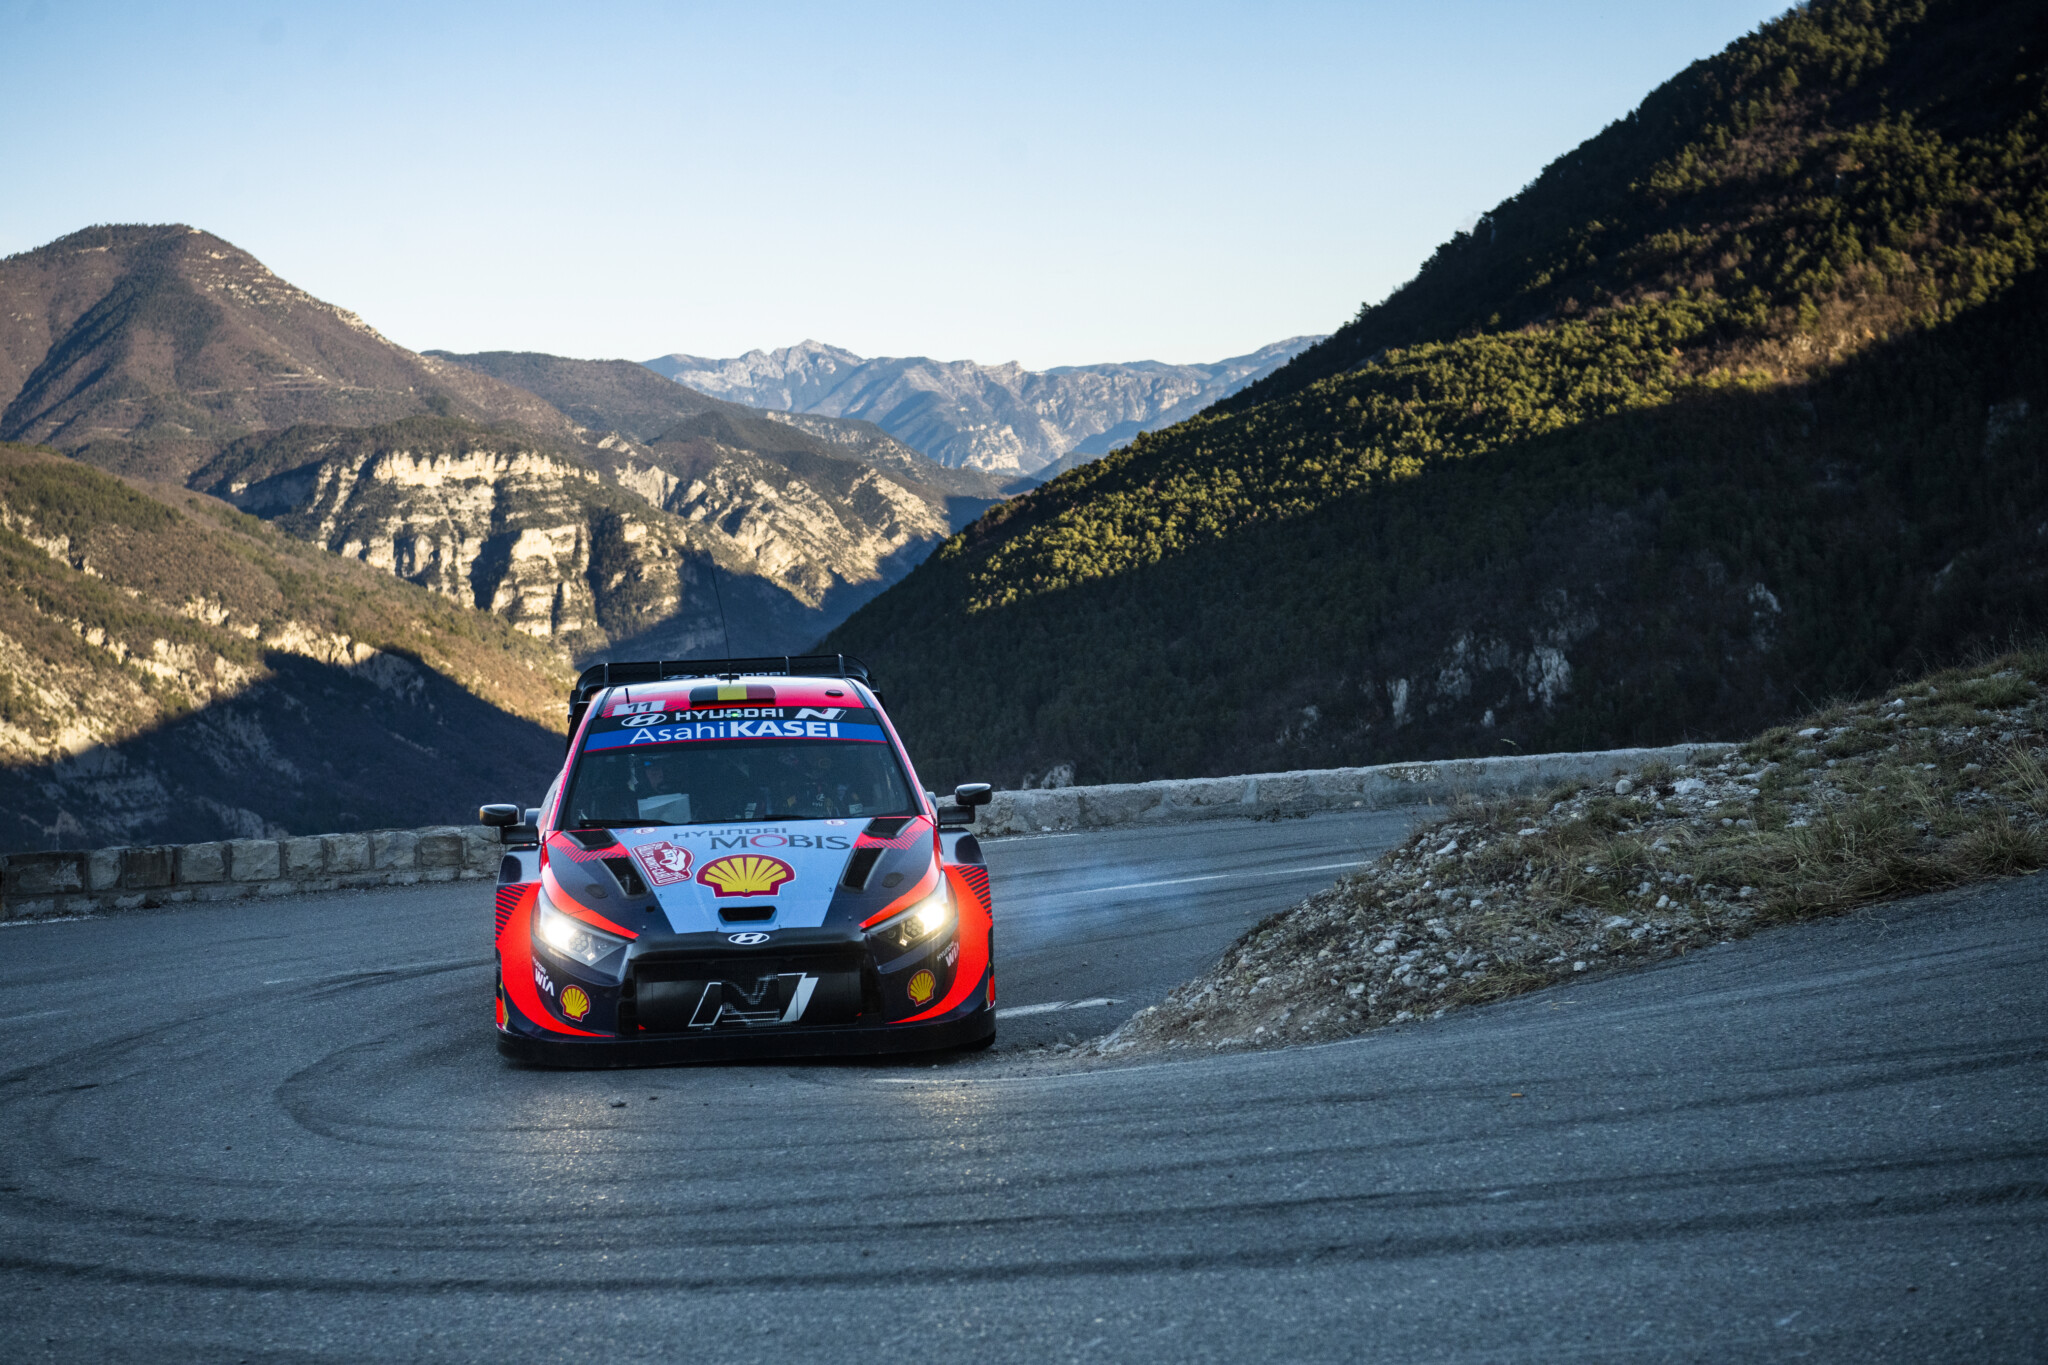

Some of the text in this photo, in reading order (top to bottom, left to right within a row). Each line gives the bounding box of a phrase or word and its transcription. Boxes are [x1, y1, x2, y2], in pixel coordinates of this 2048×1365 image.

[628, 701, 652, 713] 11
[675, 708, 784, 721] HYUNDAI
[673, 827, 787, 840] HYUNDAI
[710, 834, 851, 850] MOBIS
